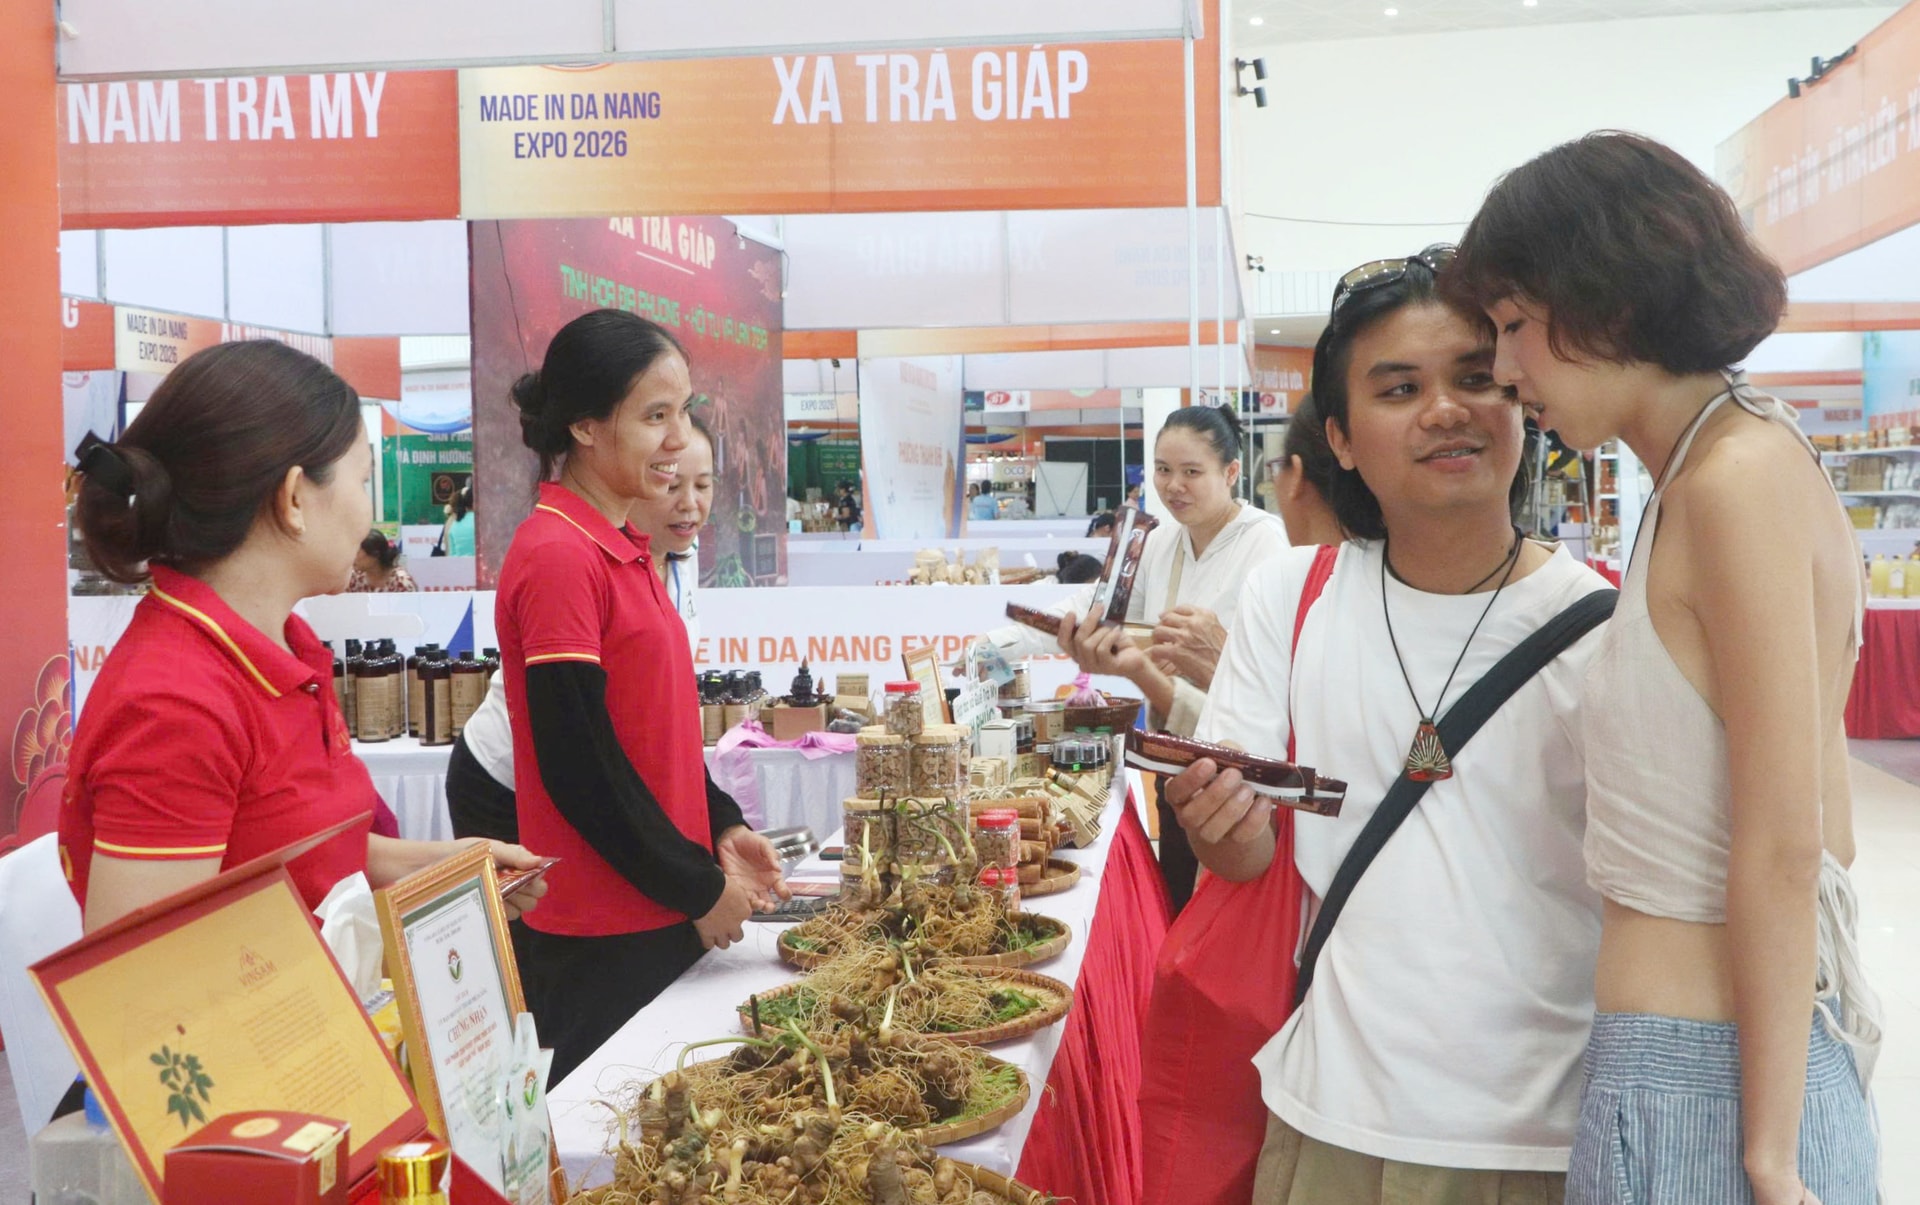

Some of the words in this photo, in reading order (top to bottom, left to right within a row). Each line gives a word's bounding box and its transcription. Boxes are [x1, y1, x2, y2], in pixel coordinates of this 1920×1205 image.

[971, 44, 1088, 121] GIÁP
[67, 80, 181, 144] NAM
[480, 94, 538, 122] MADE
[545, 94, 564, 120] IN
[571, 93, 598, 120] DA
[604, 92, 661, 119] NANG
[514, 132, 567, 159] EXPO
[574, 130, 627, 158] 2026
[678, 224, 716, 270] GIÁP
[127, 313, 148, 336] MADE
[149, 316, 158, 336] IN
[158, 318, 168, 338] DA
[168, 319, 188, 341] NANG
[139, 341, 159, 362] EXPO
[159, 343, 178, 364] 2026
[720, 636, 749, 664] IN
[758, 635, 798, 662] DA
[808, 634, 891, 663] NANG
